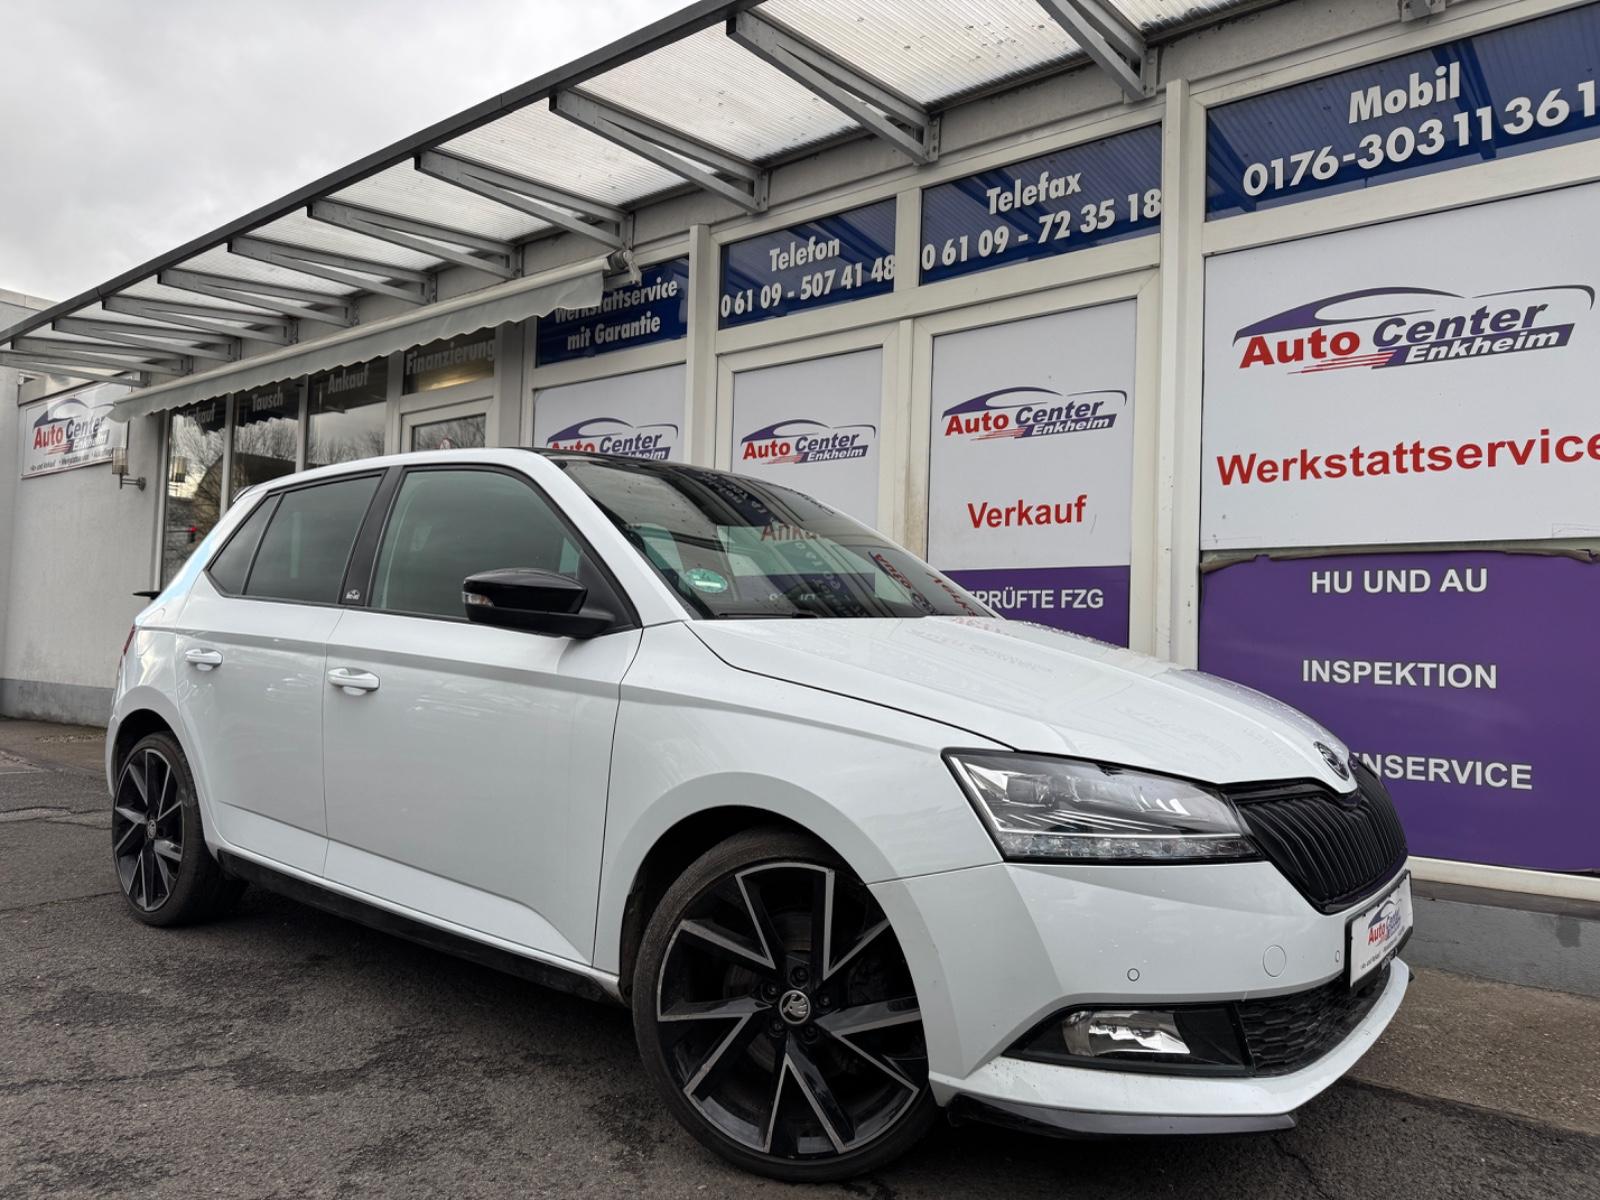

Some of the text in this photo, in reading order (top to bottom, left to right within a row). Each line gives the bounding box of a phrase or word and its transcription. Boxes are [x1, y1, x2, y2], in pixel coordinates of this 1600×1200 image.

[1348, 61, 1460, 124] Mobil
[986, 171, 1082, 215] Telefax
[978, 226, 1010, 257] 09
[1037, 210, 1071, 244] 72
[1080, 199, 1115, 234] 35
[1128, 188, 1161, 223] 18
[769, 236, 840, 272] Telefon
[760, 283, 782, 309] 09
[800, 269, 836, 301] 507
[841, 262, 863, 290] 41
[871, 254, 895, 282] 48
[567, 311, 661, 350] mit Garantie
[1239, 303, 1548, 369] Auto Center
[1405, 330, 1559, 364] Enkheim
[328, 363, 369, 394] Ankauf
[252, 385, 284, 412] Tausch
[945, 400, 1105, 436] Auto Center
[1032, 416, 1110, 436] Enkheim
[33, 424, 64, 450] Auto
[599, 433, 662, 454] Center
[743, 432, 860, 460] Auto Center
[807, 447, 863, 461] Enkheim
[1216, 429, 1600, 486] Werkstattservice
[967, 495, 1087, 529] Verkauf
[1311, 568, 1488, 594] HU UND AU
[1061, 588, 1104, 609] FZG
[1302, 660, 1497, 689] INSPEKTION
[1352, 752, 1533, 790] NSERVICE
